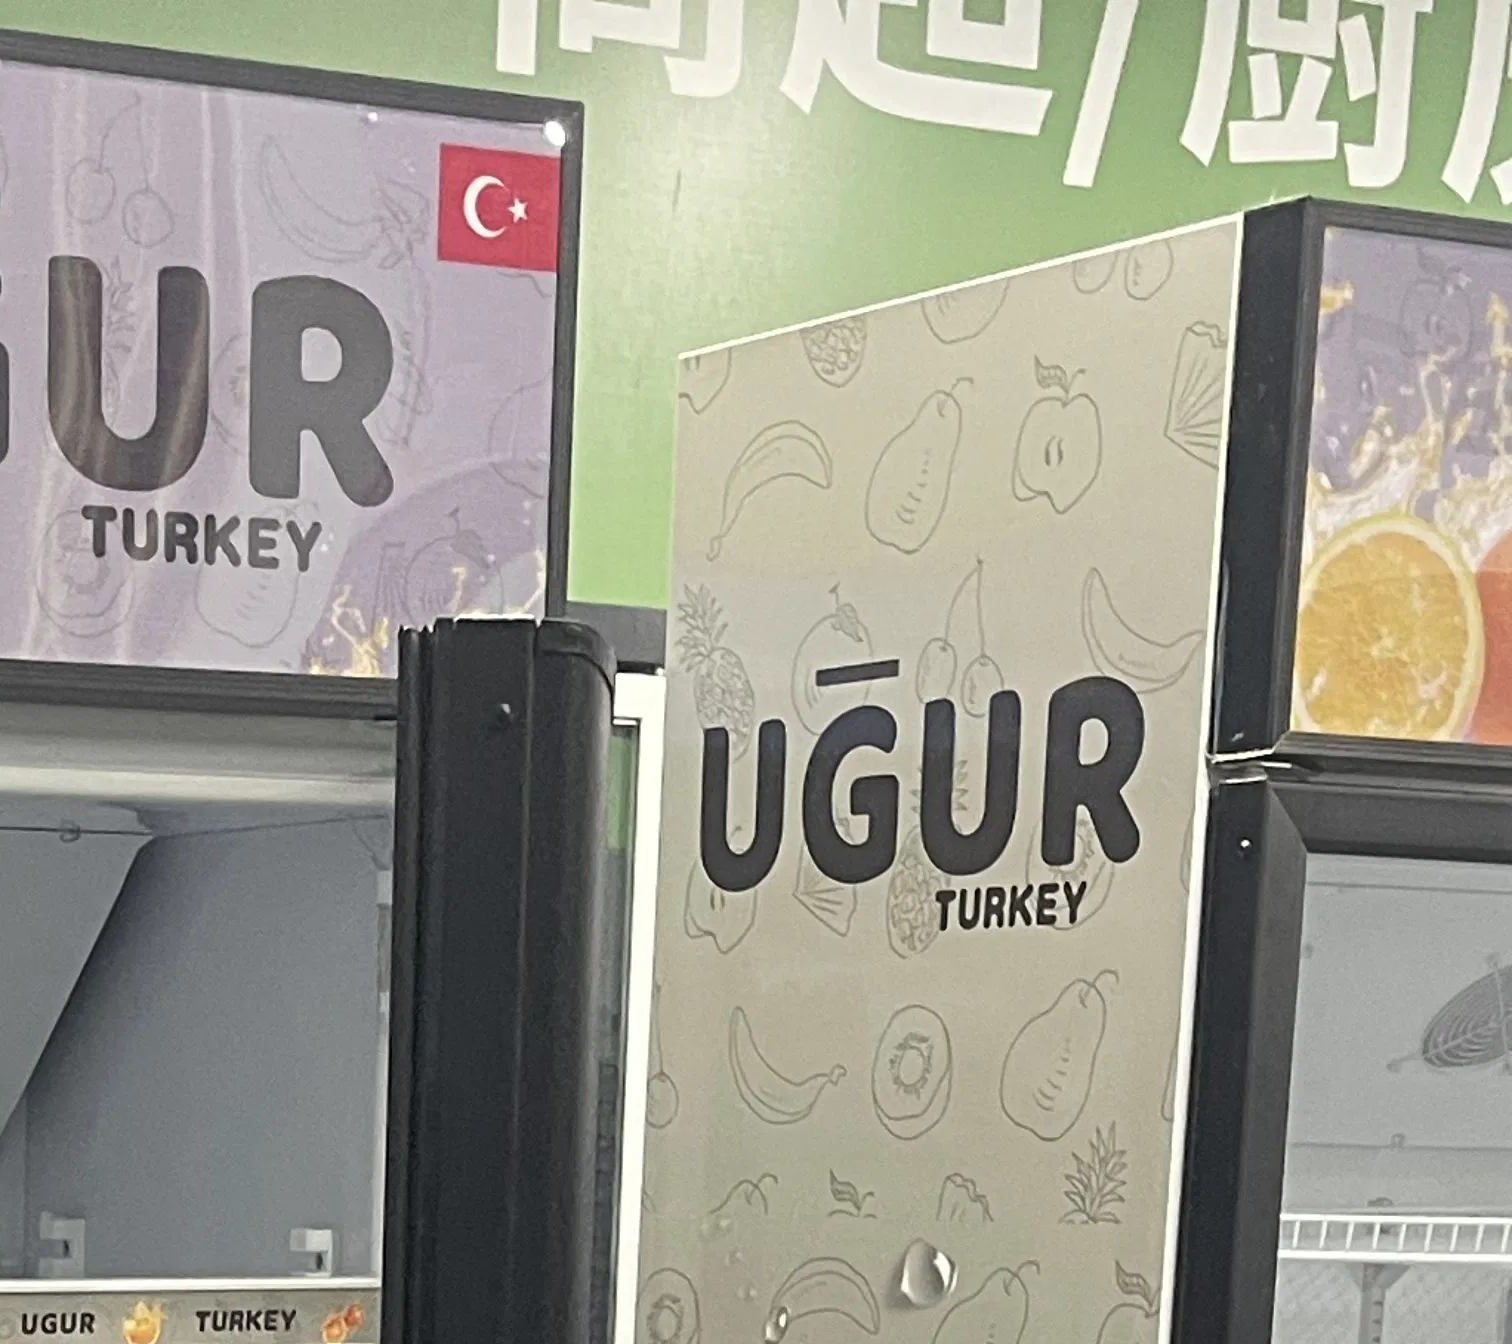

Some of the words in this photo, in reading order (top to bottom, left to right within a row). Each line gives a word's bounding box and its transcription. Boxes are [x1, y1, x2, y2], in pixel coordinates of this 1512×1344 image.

[81, 505, 324, 573] TURKEY
[935, 880, 1088, 932] TURKEY
[20, 1311, 96, 1336] UGUR
[195, 1308, 297, 1333] TURKEY
